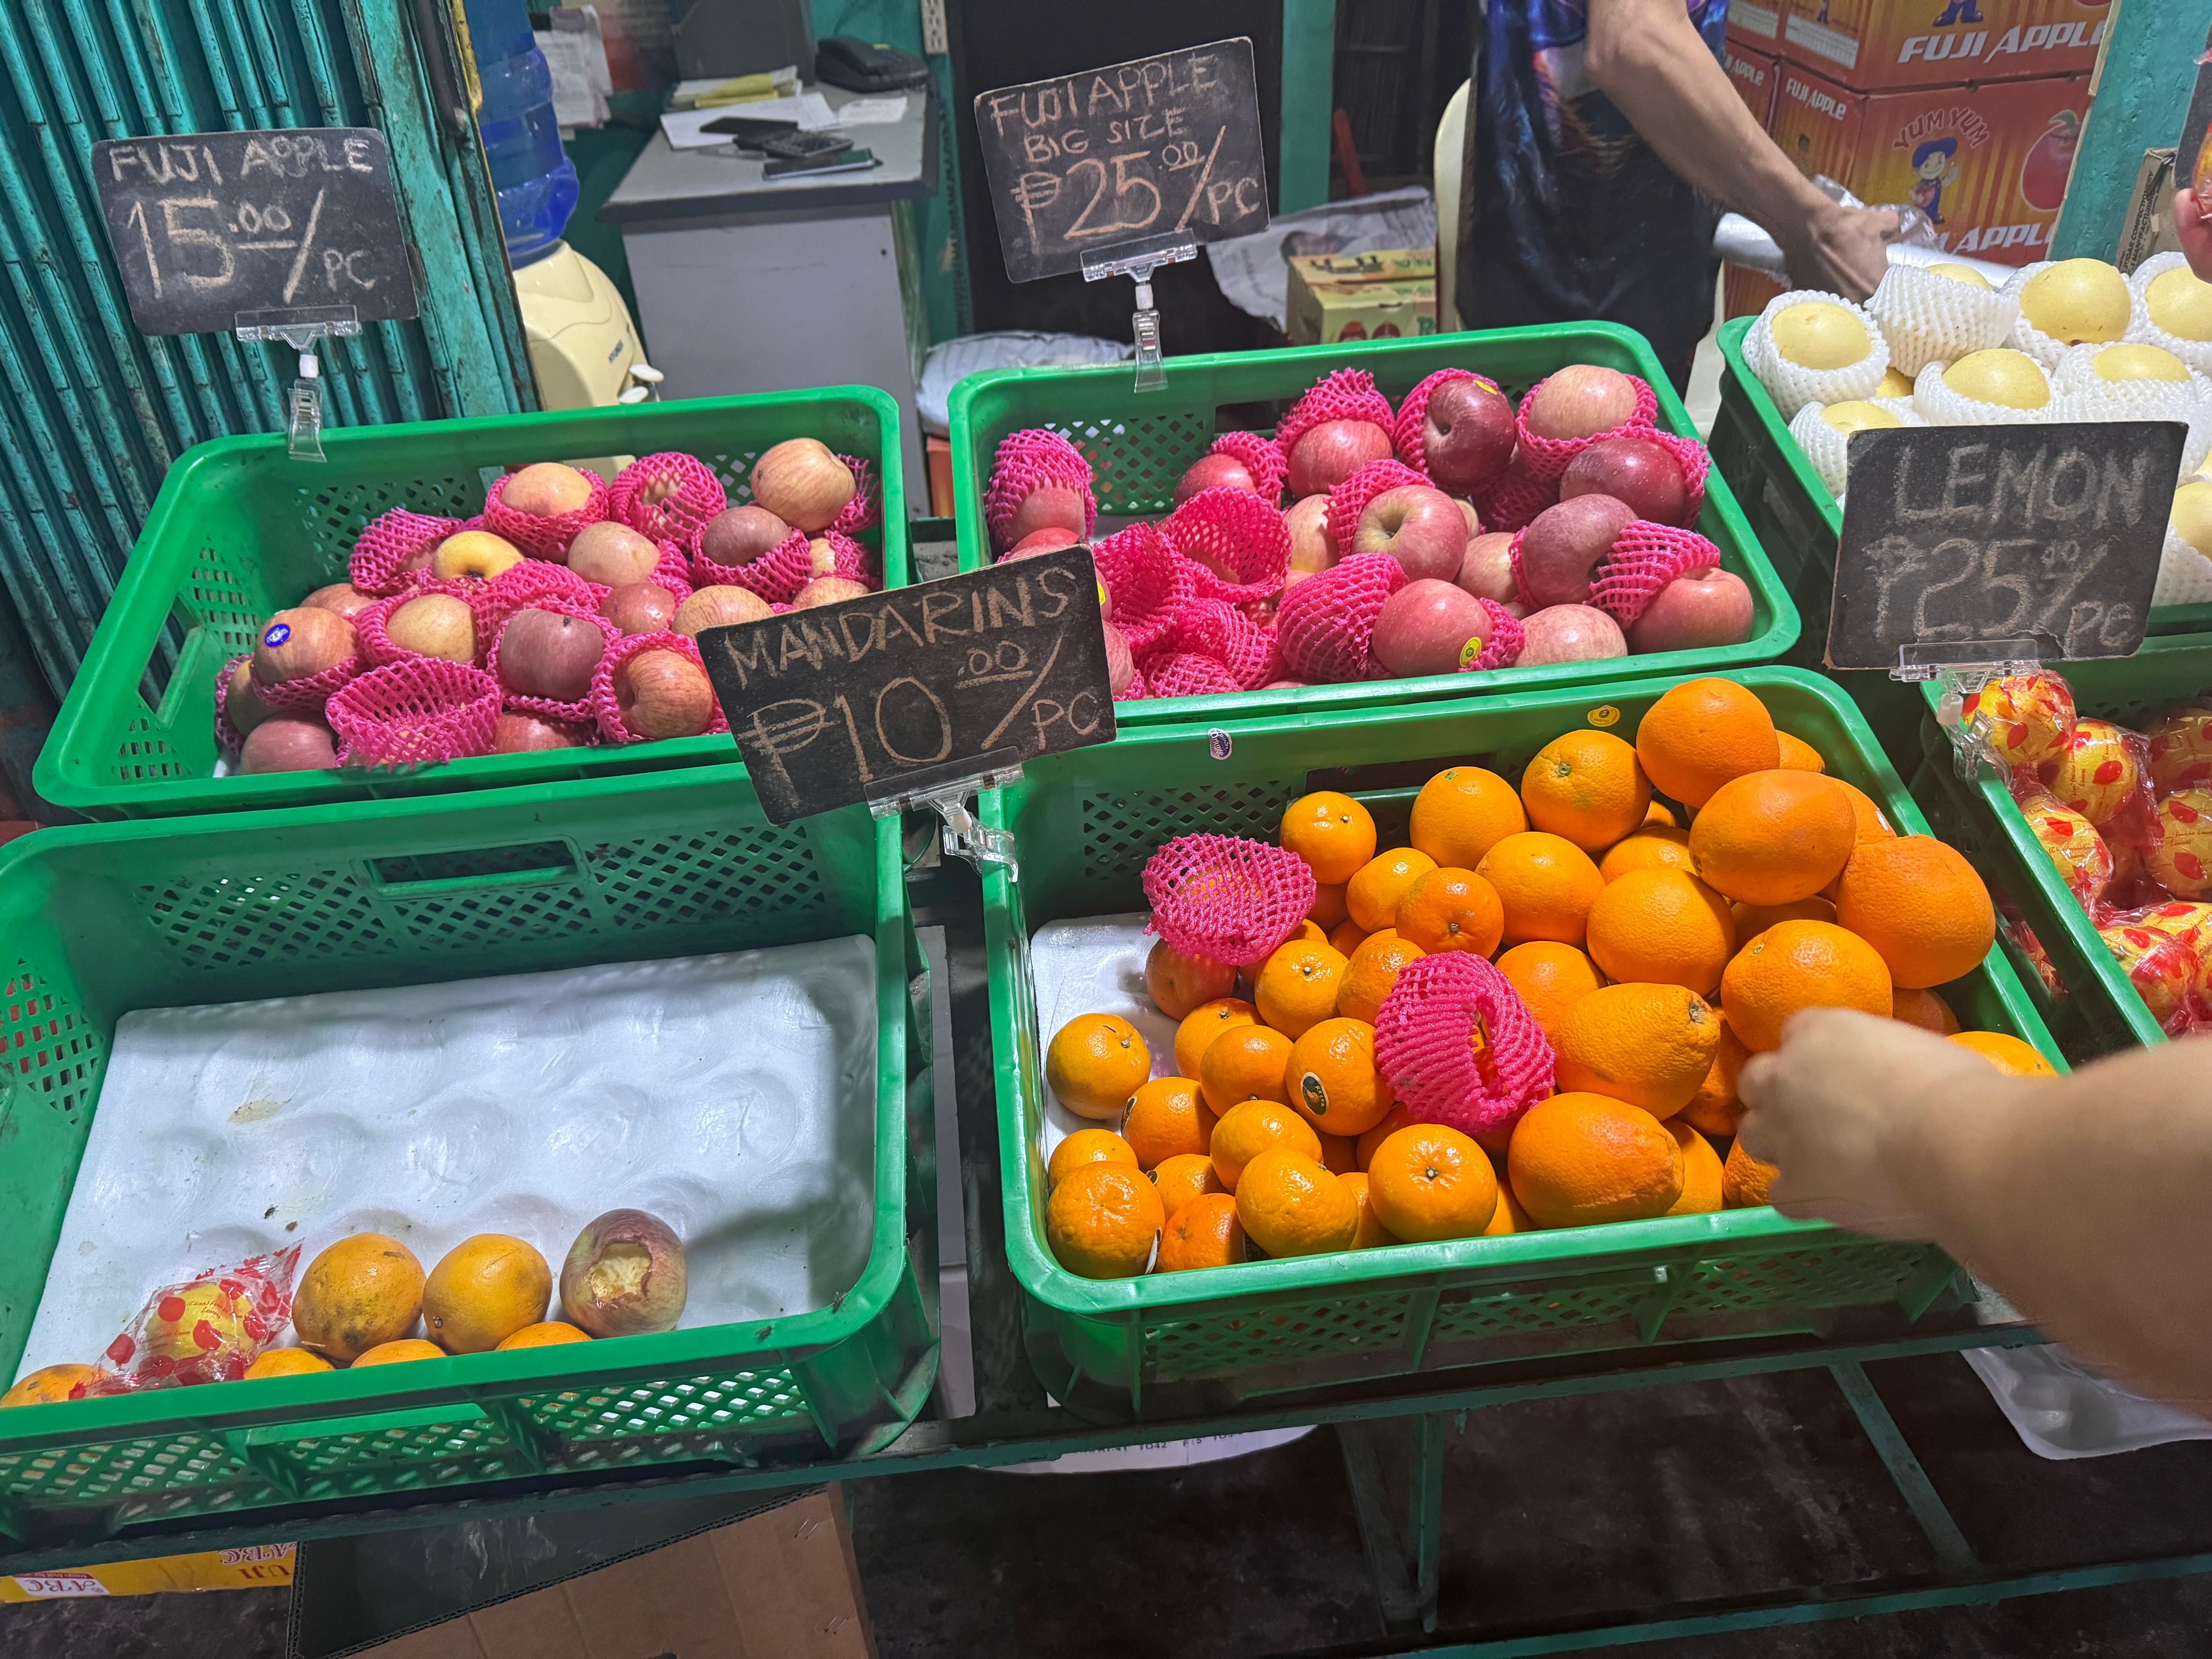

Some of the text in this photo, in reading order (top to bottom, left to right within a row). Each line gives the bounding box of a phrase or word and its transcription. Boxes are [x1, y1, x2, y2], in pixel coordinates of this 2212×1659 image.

[1898, 31, 1989, 63] FUJI
[988, 53, 1218, 137] FUJI APPLE
[1024, 107, 1189, 163] BIG SIZE
[1893, 107, 1989, 149] YUM YUM
[108, 136, 373, 185] FUJI APPLE
[1893, 443, 2151, 531] LEMON
[724, 568, 1078, 690] MANDARINS
[24, 1580, 95, 1592] ABC
